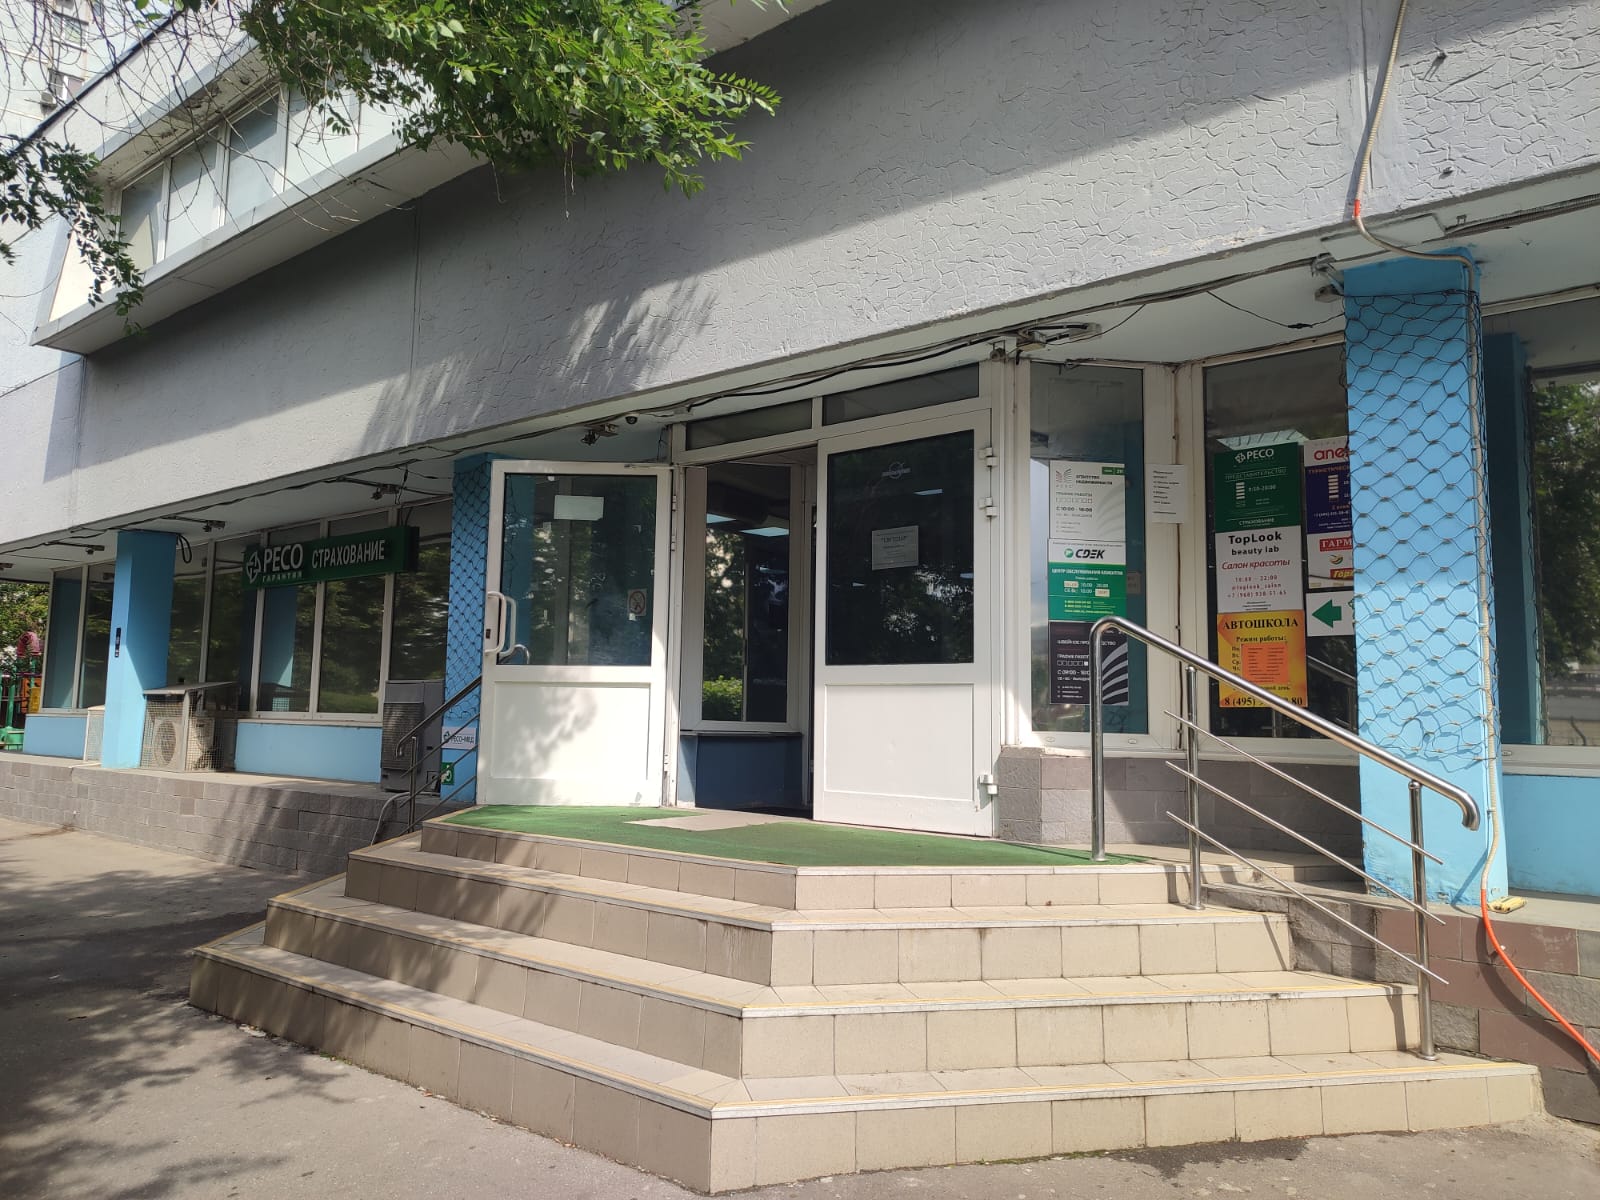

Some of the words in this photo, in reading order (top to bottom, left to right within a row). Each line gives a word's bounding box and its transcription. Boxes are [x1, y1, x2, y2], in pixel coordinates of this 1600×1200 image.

[1246, 448, 1275, 460] РЕСО
[1228, 531, 1282, 545] TopLook
[263, 543, 304, 573] РЕСО
[311, 539, 385, 569] СТРАХОВАНИЕ
[1075, 549, 1105, 559] CDEK
[1231, 547, 1263, 556] beauty
[1265, 545, 1280, 553] lab
[1222, 561, 1248, 570] Салон
[1249, 559, 1291, 570] красоты
[262, 571, 303, 582] ГАРАНТИЯ
[1223, 617, 1298, 630] АВТОШКОЛА
[1259, 635, 1287, 643] работы:
[1224, 697, 1230, 705] 8
[1232, 697, 1256, 706] (495)
